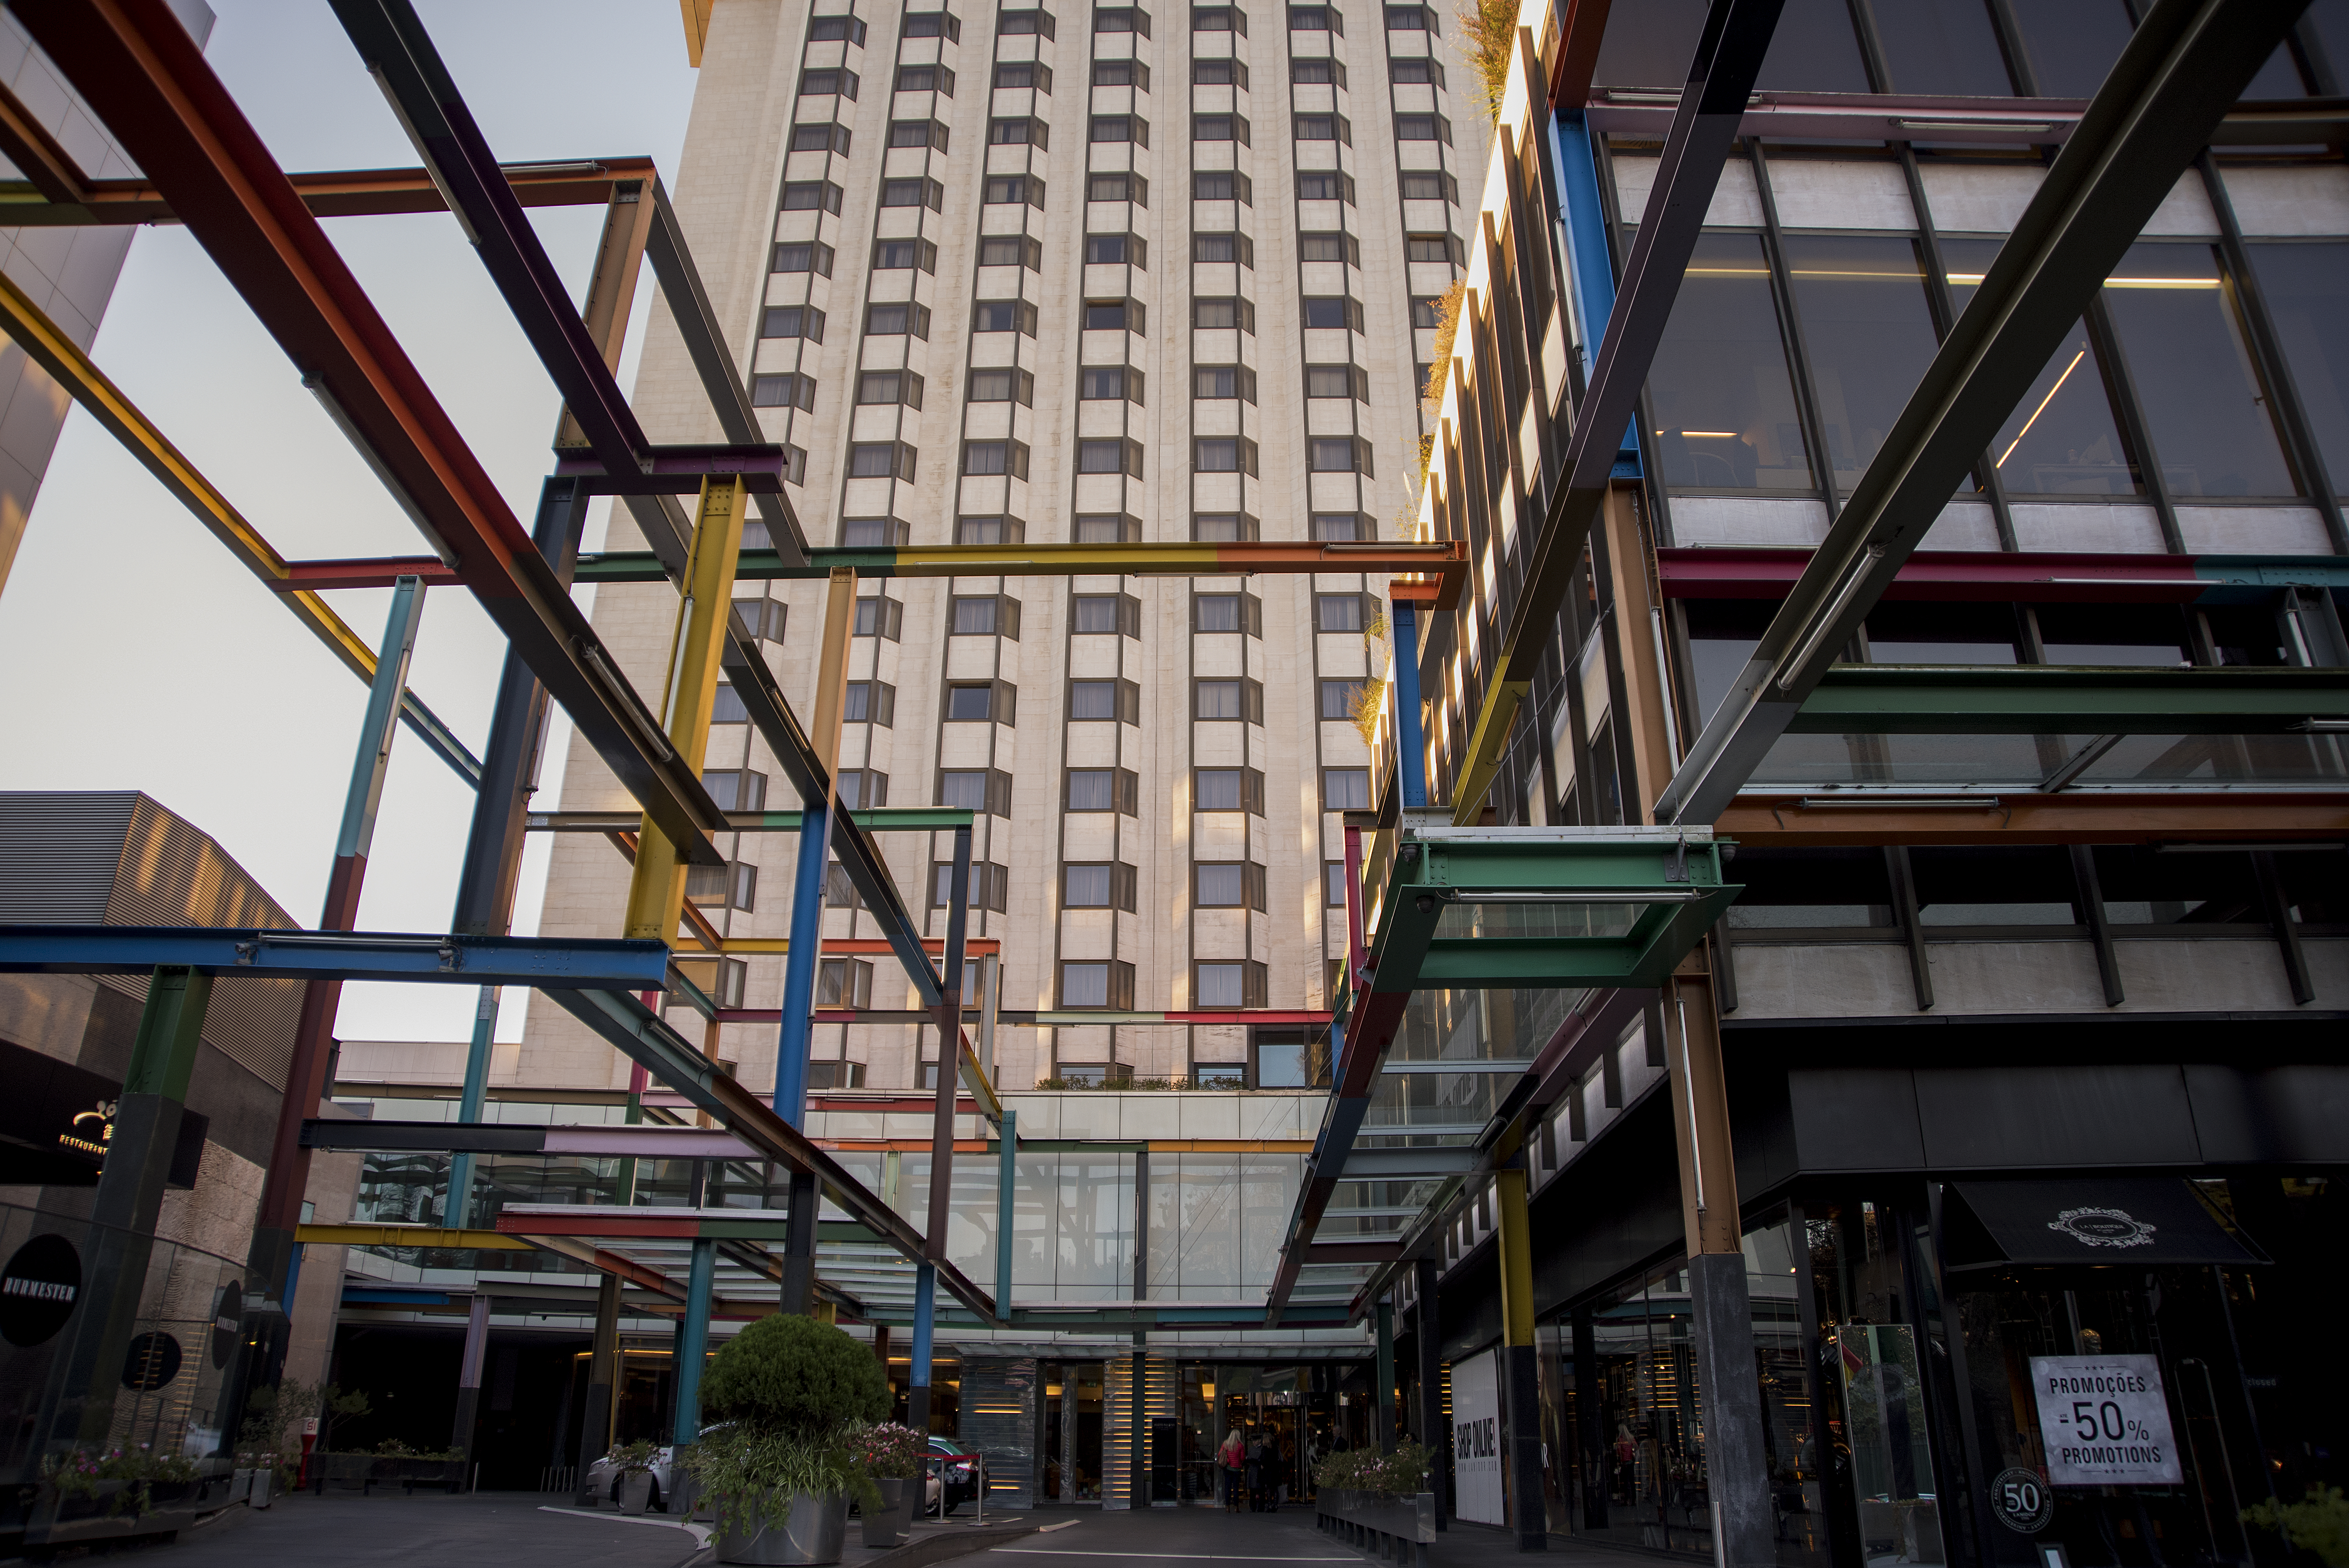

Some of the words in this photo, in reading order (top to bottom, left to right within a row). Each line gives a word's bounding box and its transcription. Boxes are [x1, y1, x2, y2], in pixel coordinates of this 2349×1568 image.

[3, 1277, 76, 1302] BURMESTER
[2050, 1372, 2146, 1397] PROMOÇÕES
[1458, 1423, 1472, 1460] SHOP
[1473, 1417, 1496, 1458] ONLINE!
[2062, 1446, 2162, 1464] PROMOTIONS
[2004, 1483, 2040, 1512] 50
